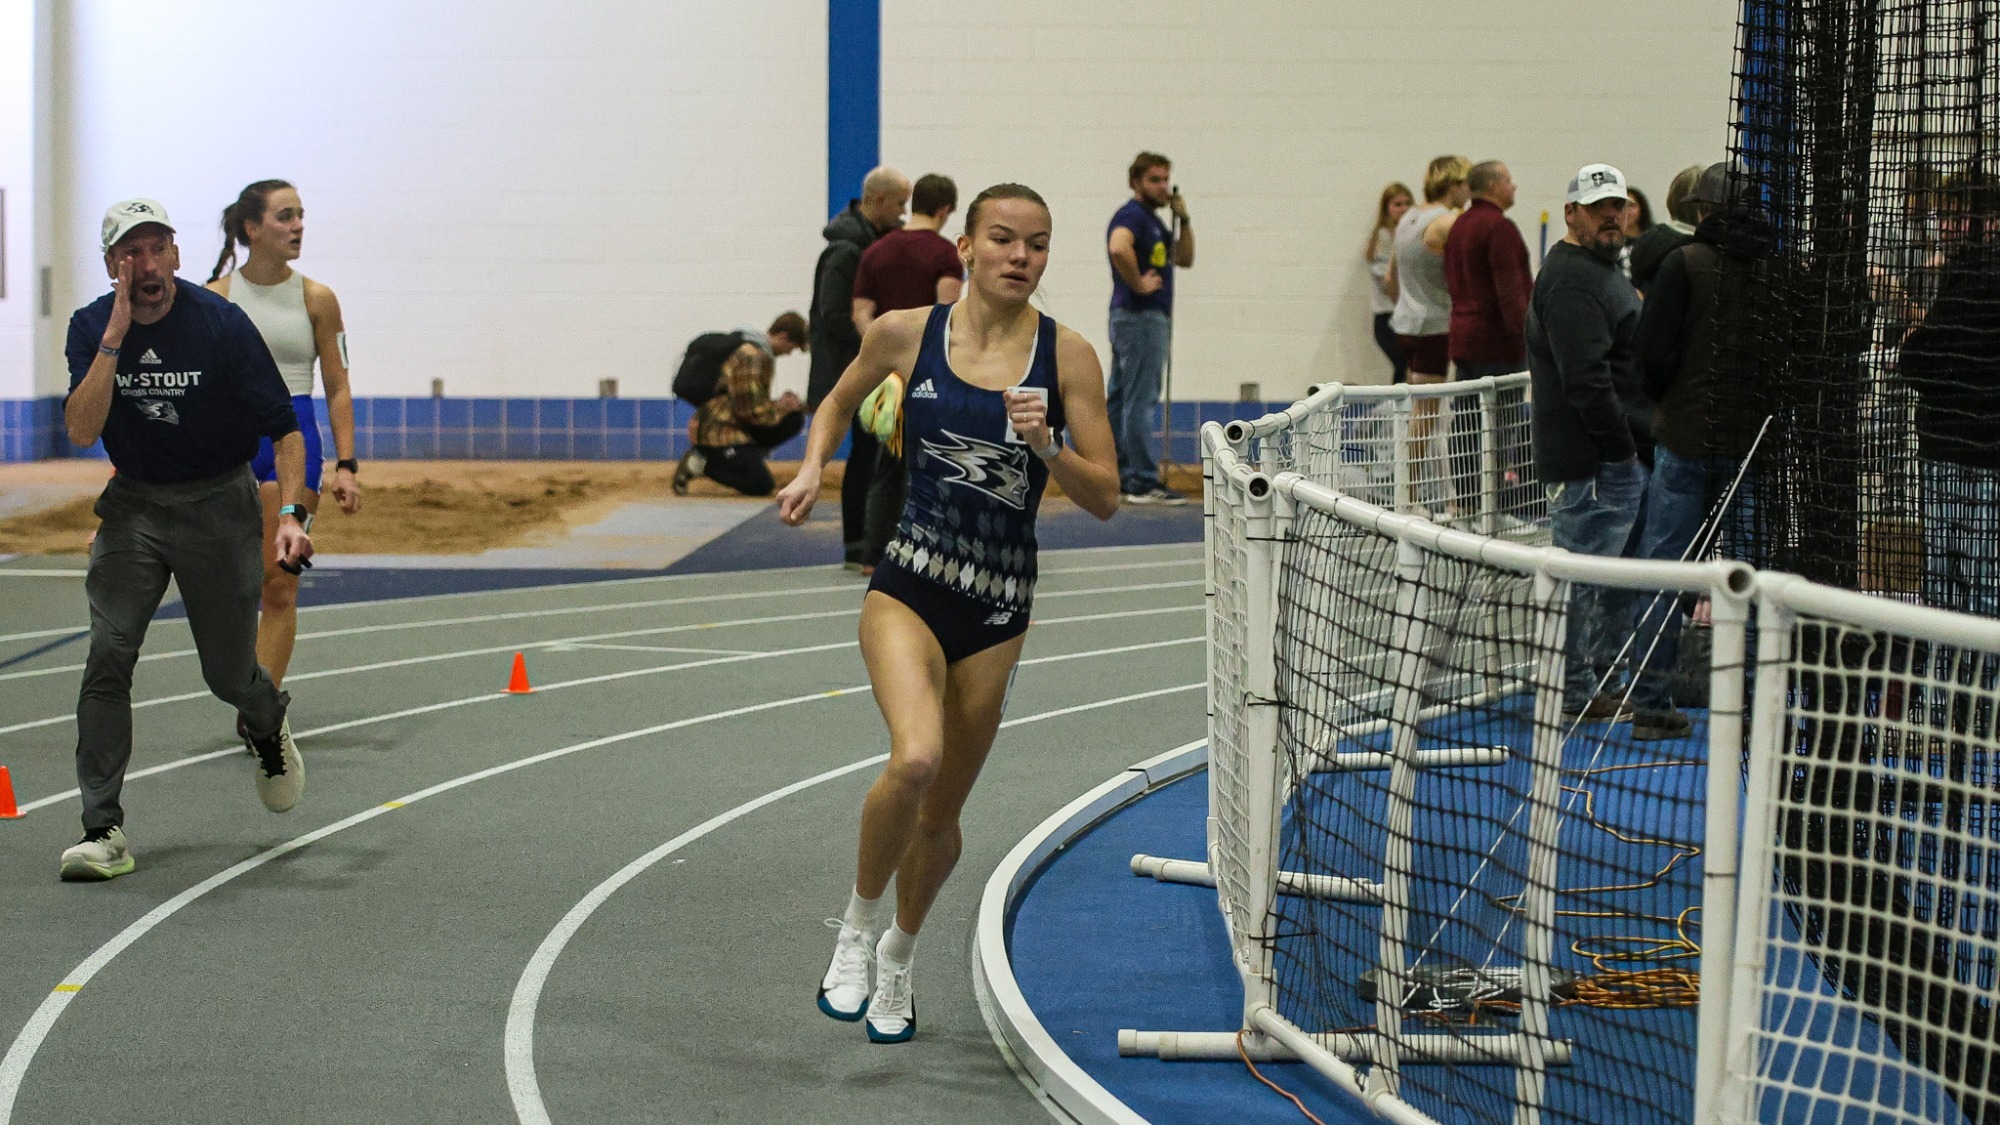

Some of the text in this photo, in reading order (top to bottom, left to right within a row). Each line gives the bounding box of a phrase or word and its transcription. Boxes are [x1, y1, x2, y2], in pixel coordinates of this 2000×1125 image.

[116, 371, 202, 388] W-STOUT
[121, 388, 186, 397] CROSS COUNTRY
[912, 391, 938, 399] adidas
